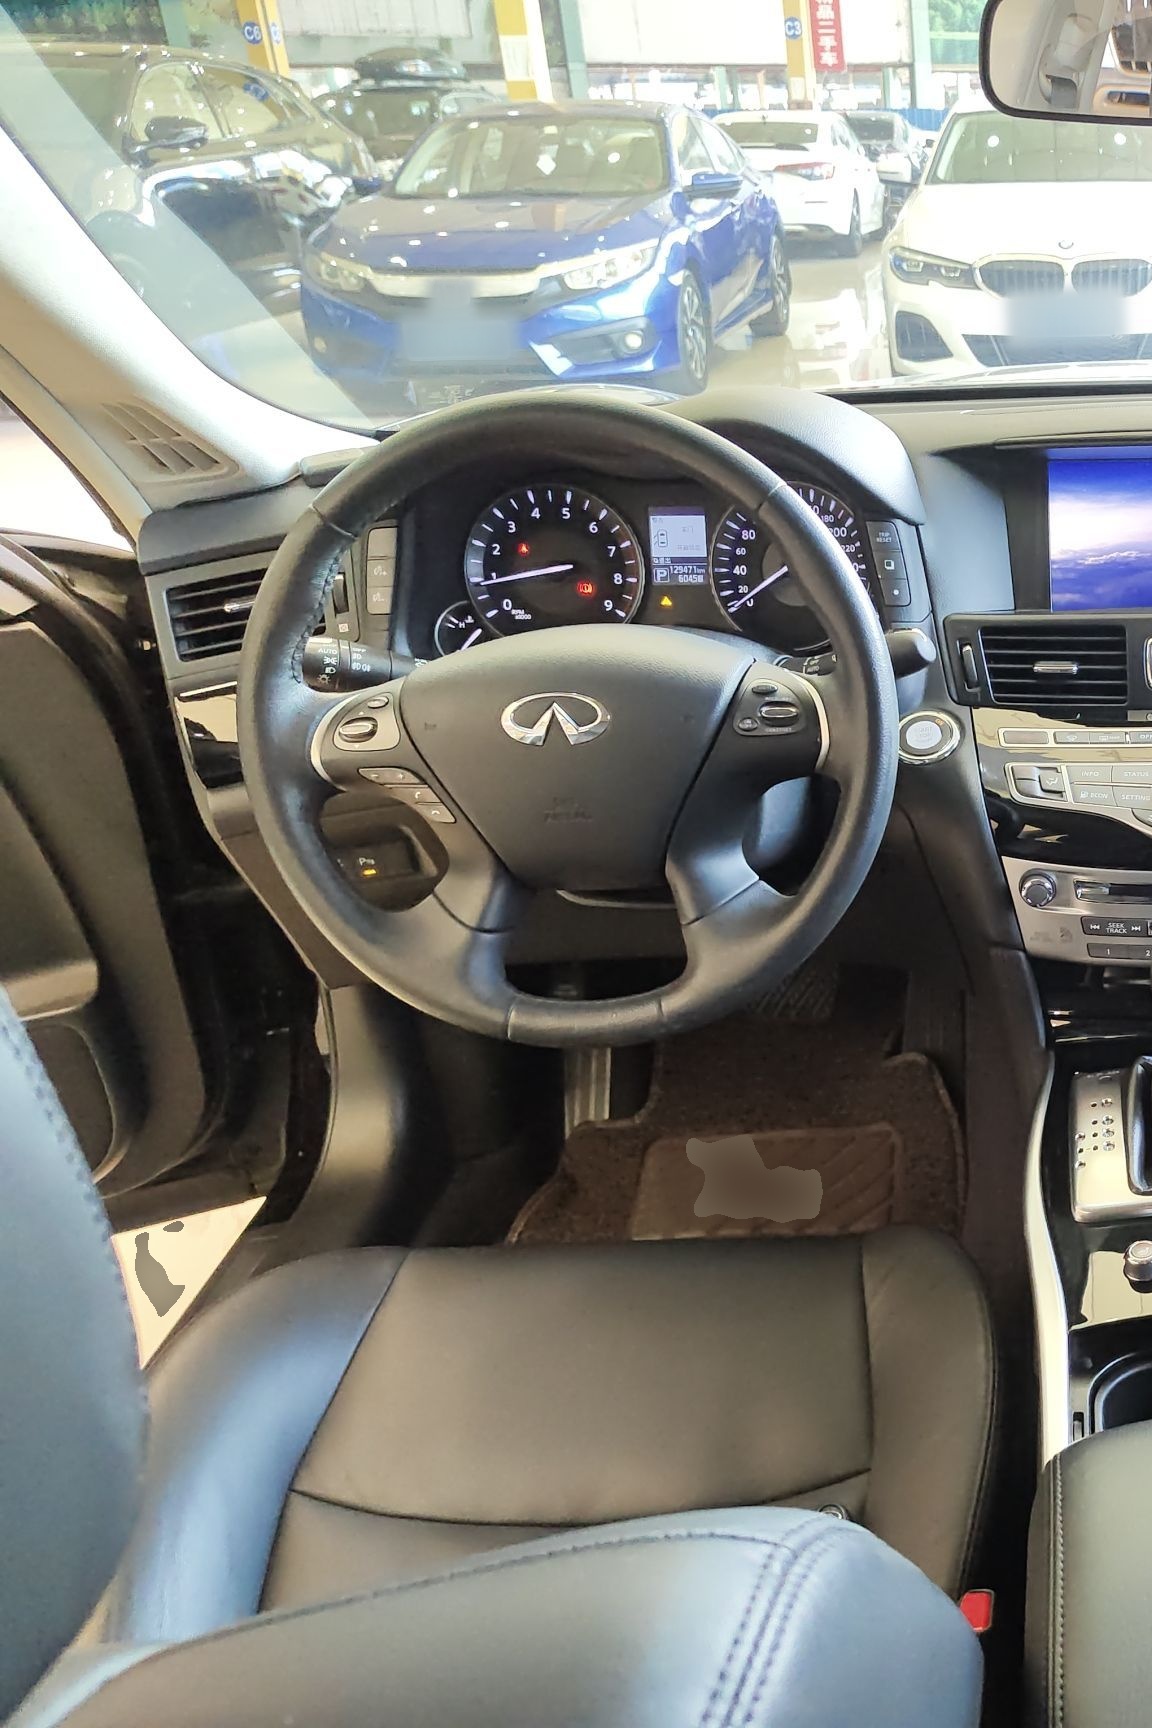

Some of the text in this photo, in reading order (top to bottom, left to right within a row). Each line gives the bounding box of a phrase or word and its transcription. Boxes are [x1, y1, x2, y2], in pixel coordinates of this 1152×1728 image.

[785, 21, 801, 36] C3
[531, 507, 540, 519] 4
[562, 507, 571, 519] 5
[508, 521, 516, 533] 3
[589, 522, 598, 533] 6
[742, 530, 756, 540] 80
[492, 544, 501, 555] 2
[607, 546, 616, 558] 7
[736, 547, 746, 555] 60
[656, 569, 667, 581] P
[733, 565, 747, 575] 40
[613, 573, 622, 584] 8
[738, 585, 748, 593] 20
[503, 599, 512, 610] 0
[604, 600, 613, 611] 9
